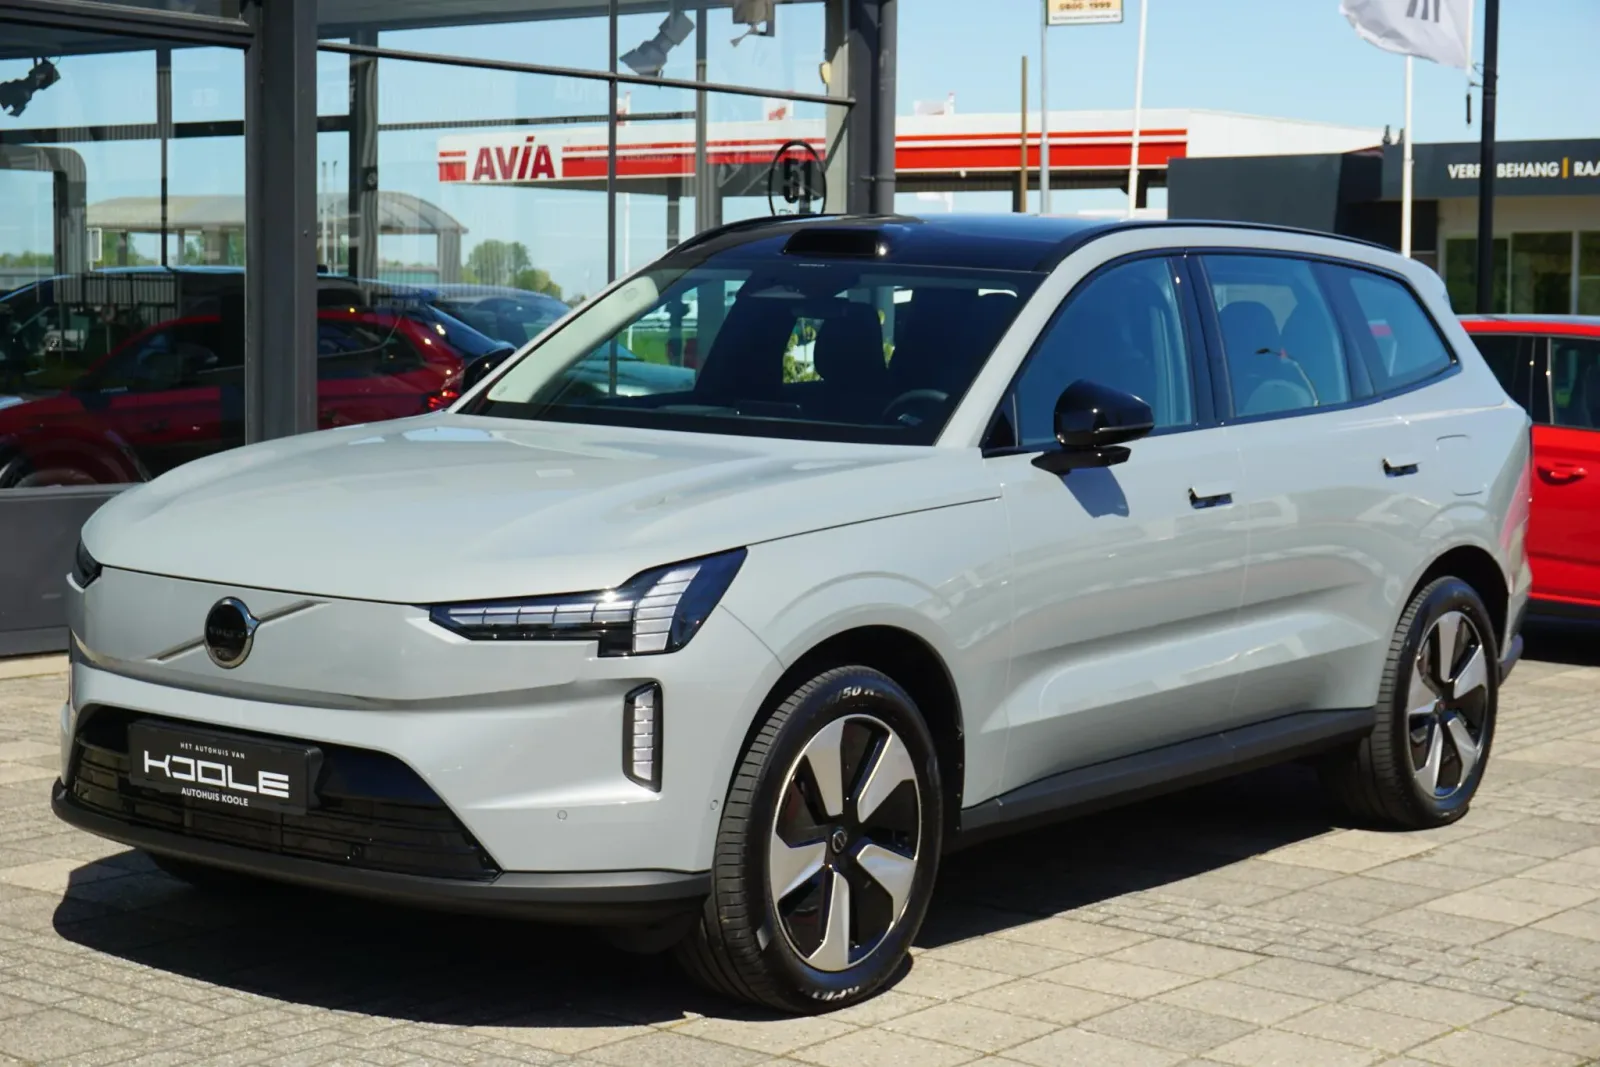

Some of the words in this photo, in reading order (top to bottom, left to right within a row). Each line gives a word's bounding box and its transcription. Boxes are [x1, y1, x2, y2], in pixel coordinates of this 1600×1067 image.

[1496, 161, 1560, 178] BEHANG
[180, 742, 192, 750] HET
[195, 745, 229, 757] AUTOHUIS
[231, 751, 245, 759] VAN
[143, 750, 289, 798] KOOLE
[181, 787, 220, 802] AUTOHUIS
[221, 794, 249, 807] KOOLE
